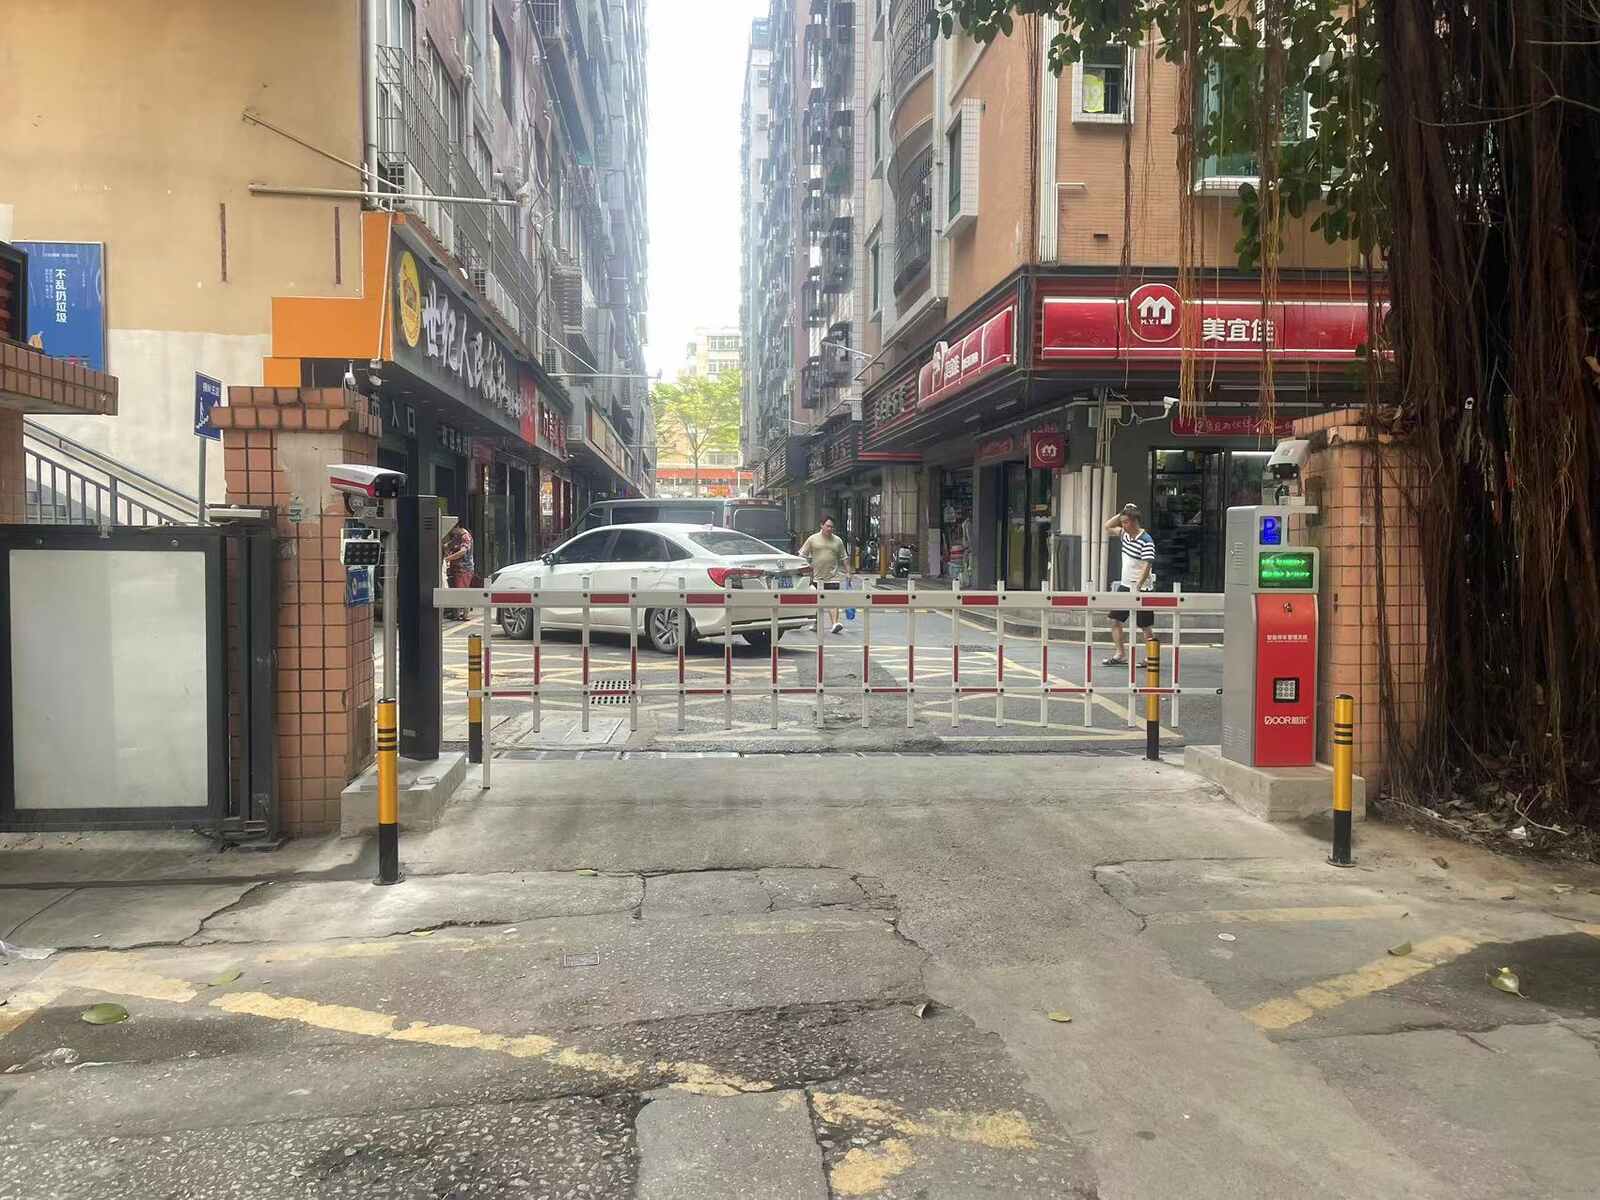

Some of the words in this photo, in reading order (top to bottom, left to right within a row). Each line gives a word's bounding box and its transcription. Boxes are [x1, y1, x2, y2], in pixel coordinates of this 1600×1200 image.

[55, 268, 67, 323] 不乱扔垃圾
[1202, 317, 1275, 343] 美宜佳
